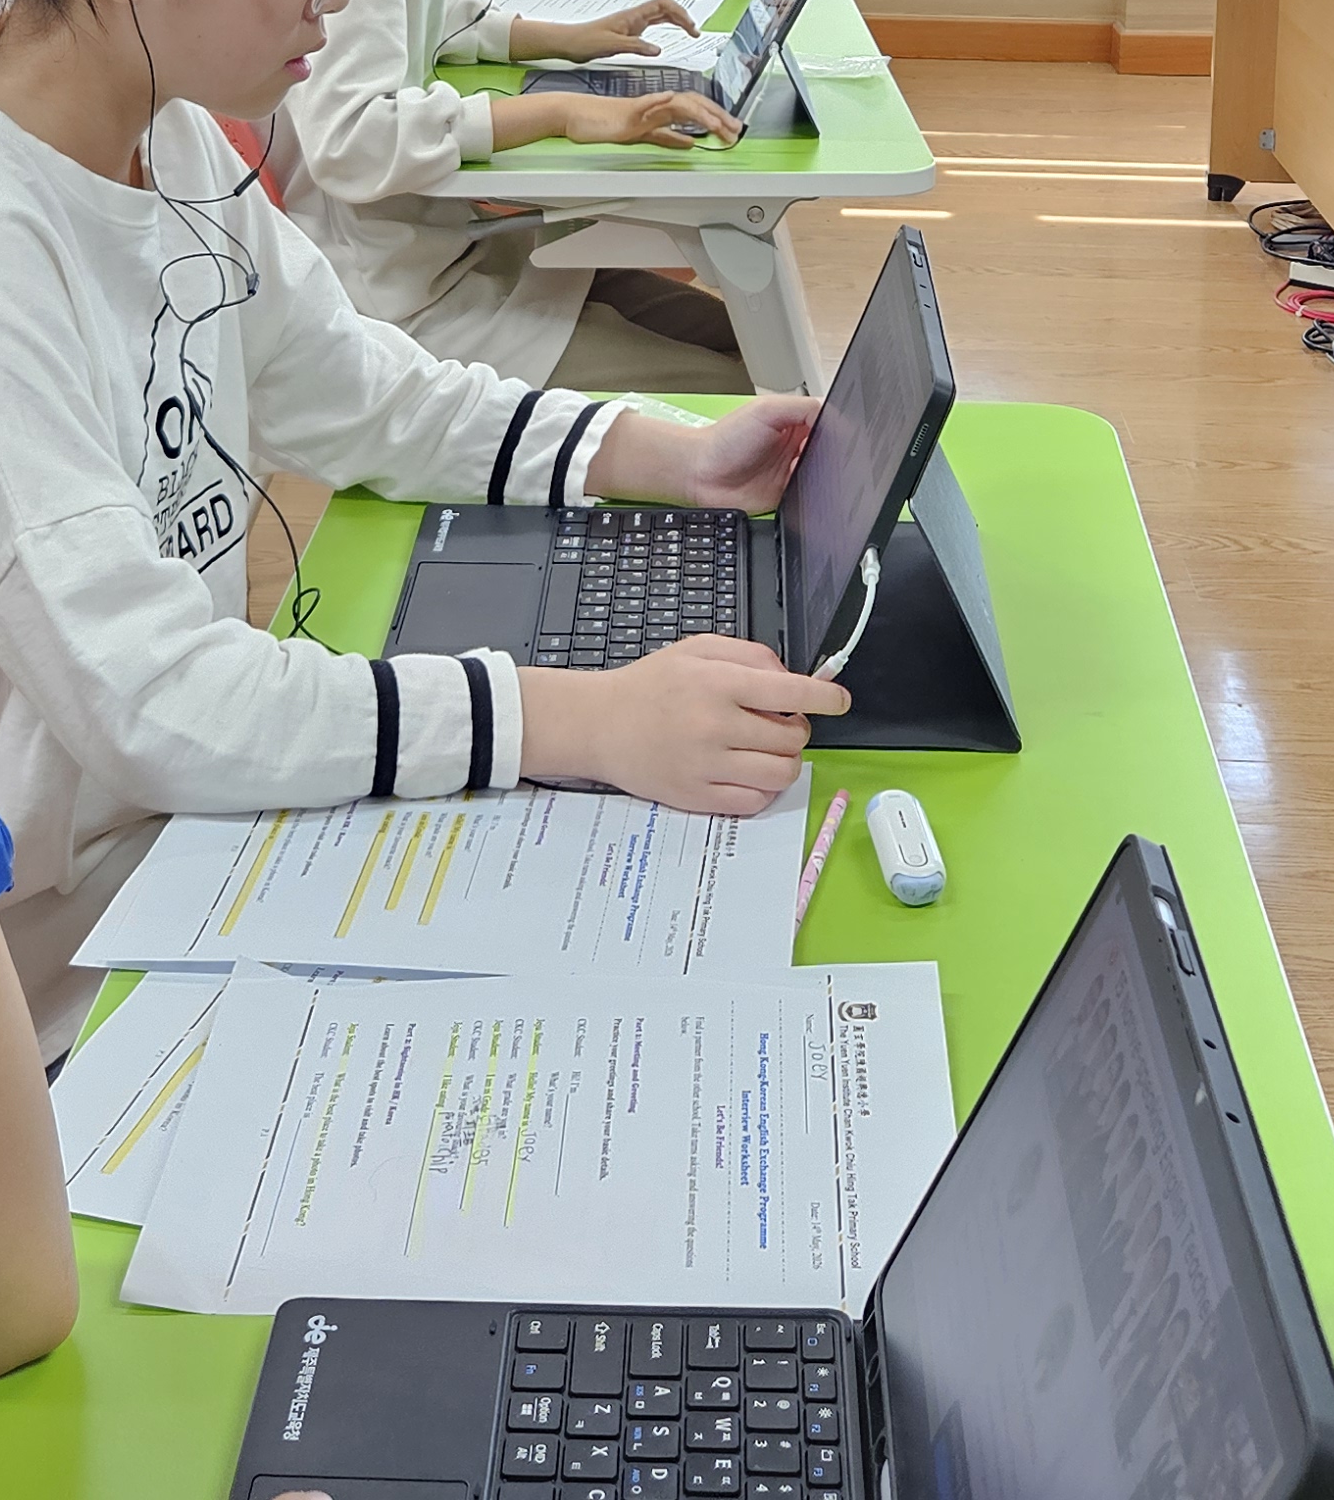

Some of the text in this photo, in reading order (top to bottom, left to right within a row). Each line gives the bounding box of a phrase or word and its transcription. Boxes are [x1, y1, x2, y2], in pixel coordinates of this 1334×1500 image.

[635, 1018, 644, 1032] Part
[631, 1041, 643, 1067] Meeting
[632, 1069, 641, 1081] and
[627, 1083, 640, 1113] Greeting
[716, 1125, 725, 1134] Be
[740, 1091, 751, 1185] Interview Worksheet
[757, 1033, 769, 1249] Hong Kong-Korean English Exchange Programme
[839, 1025, 861, 1269] The Yuen Yuen Institute Chan Kwok Chiu Hing Tak Primary School
[650, 1323, 663, 1359] Caps Lock
[526, 1364, 537, 1375] Fn
[711, 1377, 731, 1388] Q
[283, 1346, 321, 1441] 제주특별자치도교육청
[653, 1386, 670, 1396] A
[536, 1397, 551, 1423] Option
[594, 1404, 611, 1414] Z
[652, 1426, 670, 1436] S
[715, 1417, 732, 1432] W
[515, 1446, 528, 1460] Alt
[534, 1444, 546, 1463] CMD
[591, 1445, 608, 1456] X
[714, 1459, 732, 1469] E
[651, 1468, 668, 1480] D
